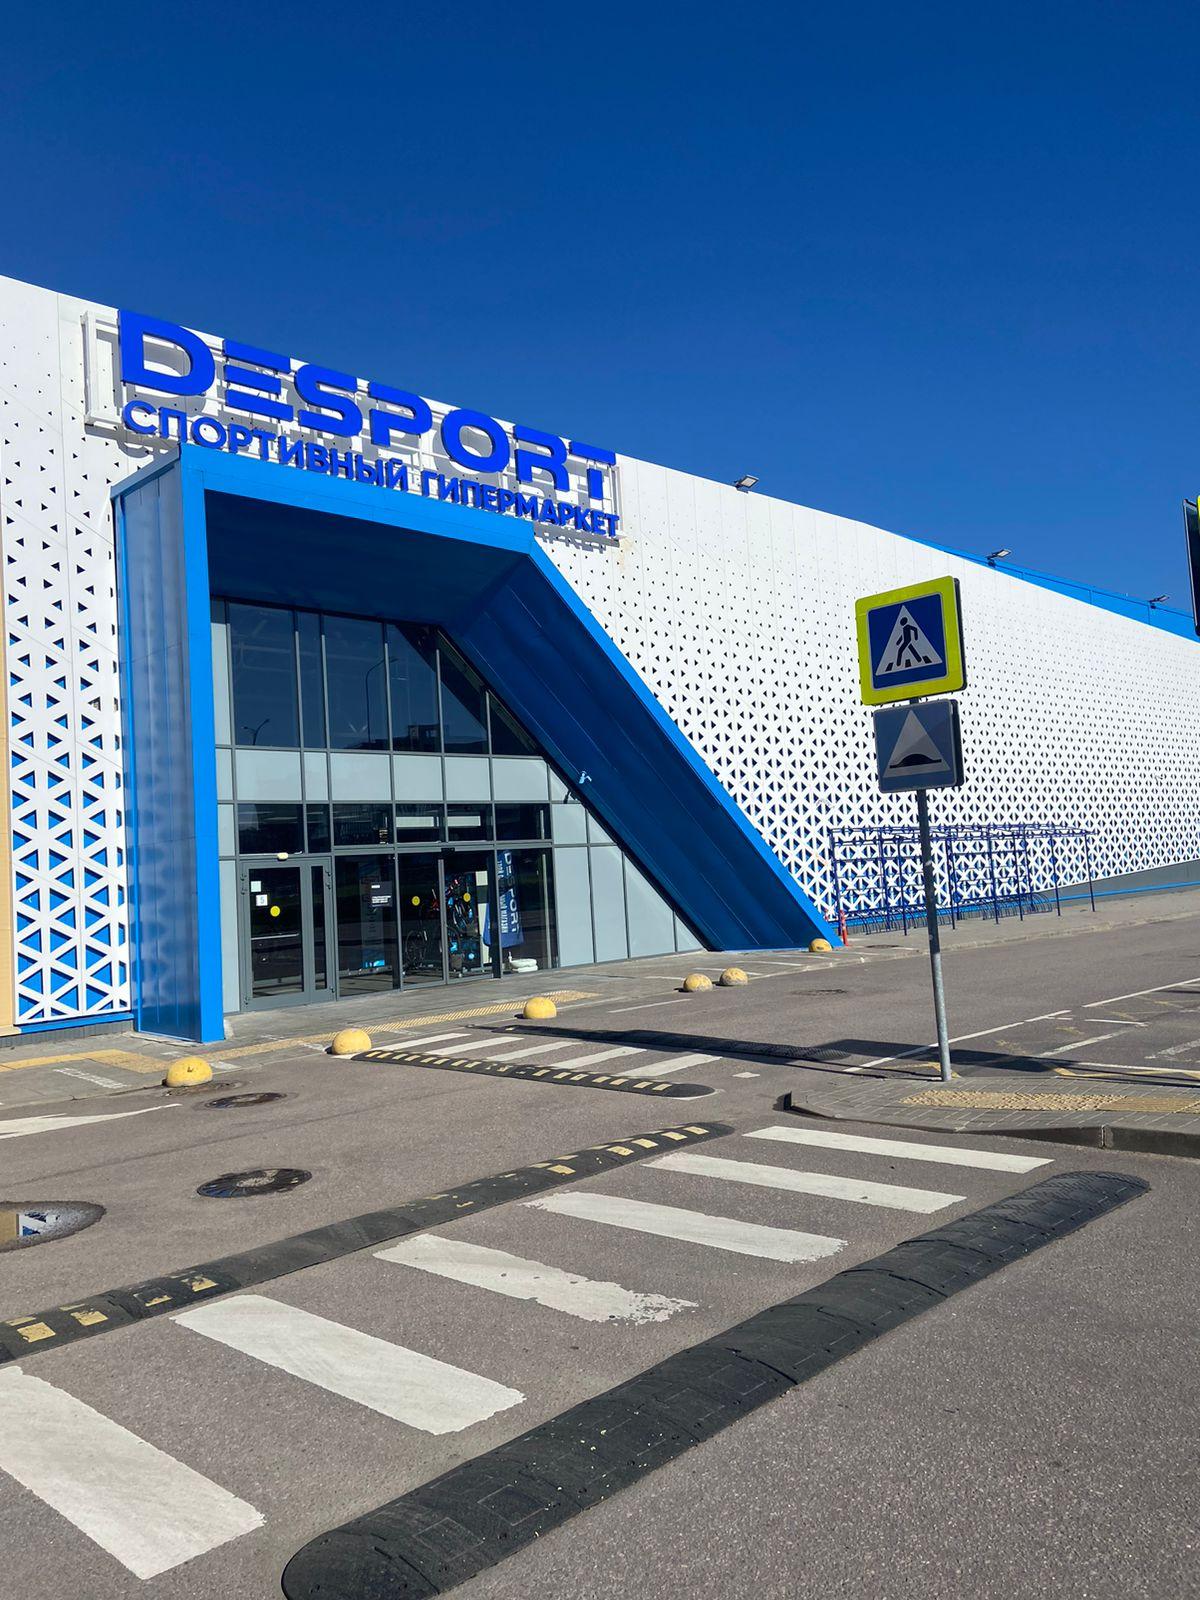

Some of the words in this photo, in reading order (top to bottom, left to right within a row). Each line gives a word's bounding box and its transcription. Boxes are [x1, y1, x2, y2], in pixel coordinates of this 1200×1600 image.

[118, 309, 615, 499] DESPORT
[122, 401, 407, 490] СПОРТИВНЫЙ
[422, 470, 620, 537] ГИПЕРМАРКЕТ
